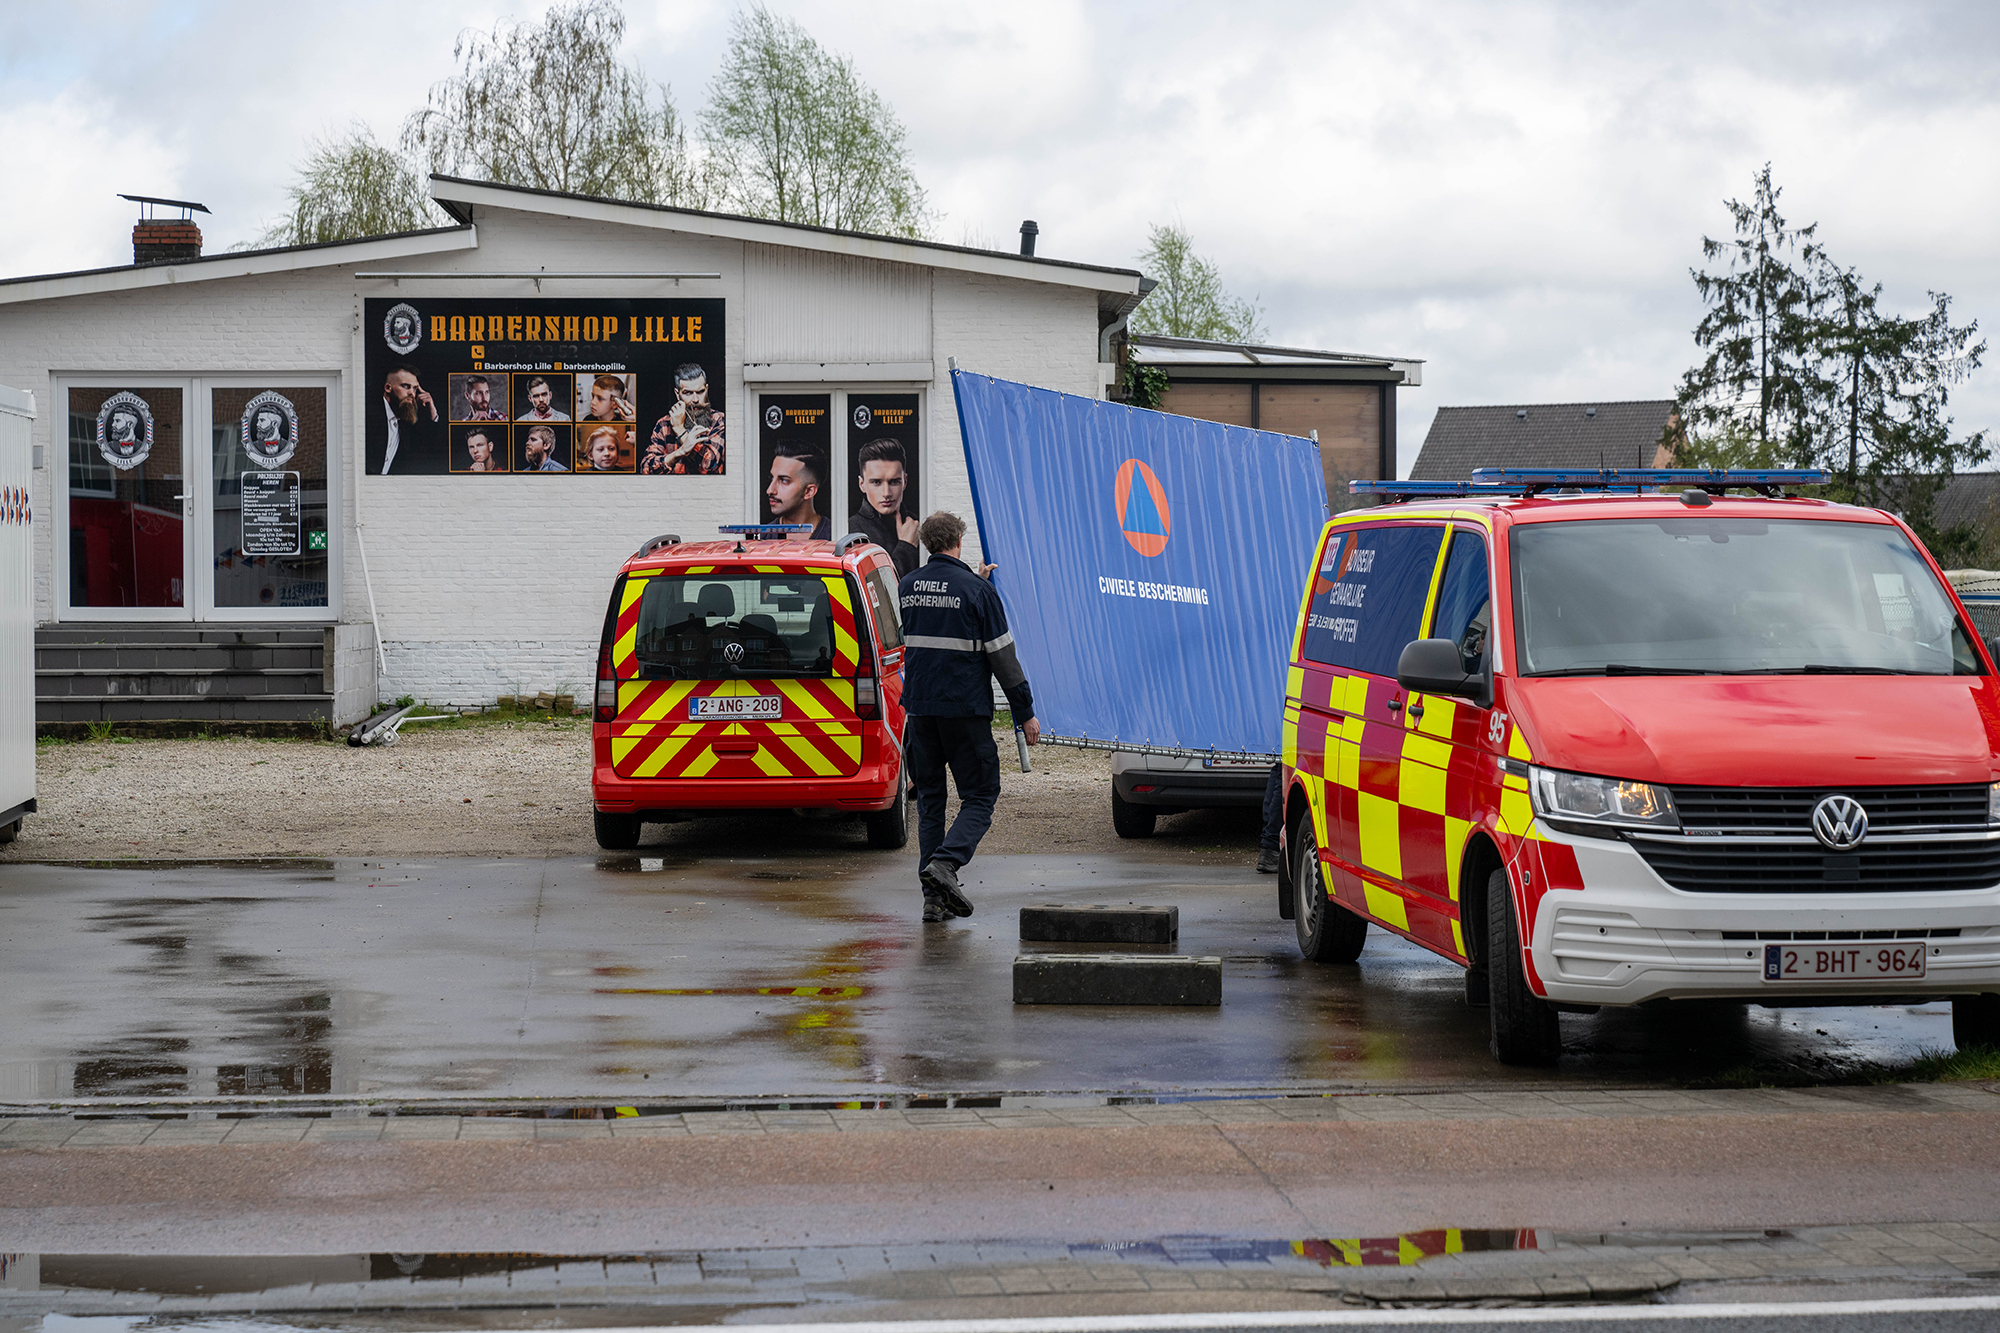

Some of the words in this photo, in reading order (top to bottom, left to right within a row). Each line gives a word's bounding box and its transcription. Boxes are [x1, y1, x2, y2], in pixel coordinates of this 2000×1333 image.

[430, 314, 618, 342] BARBERSHOP
[629, 315, 702, 343] LILLE
[484, 362, 533, 372] Barbershop
[534, 362, 552, 371] Lille
[563, 362, 626, 372] barbershoplille
[794, 416, 816, 424] LILLE
[882, 416, 904, 424] LILLE
[913, 580, 949, 593] CIVIELE
[1098, 576, 1136, 598] CIVIELE
[1137, 581, 1209, 605] BESCHERMING
[900, 594, 961, 609] BESCHERMING
[1487, 711, 1508, 744] 95
[1768, 964, 1778, 975] B
